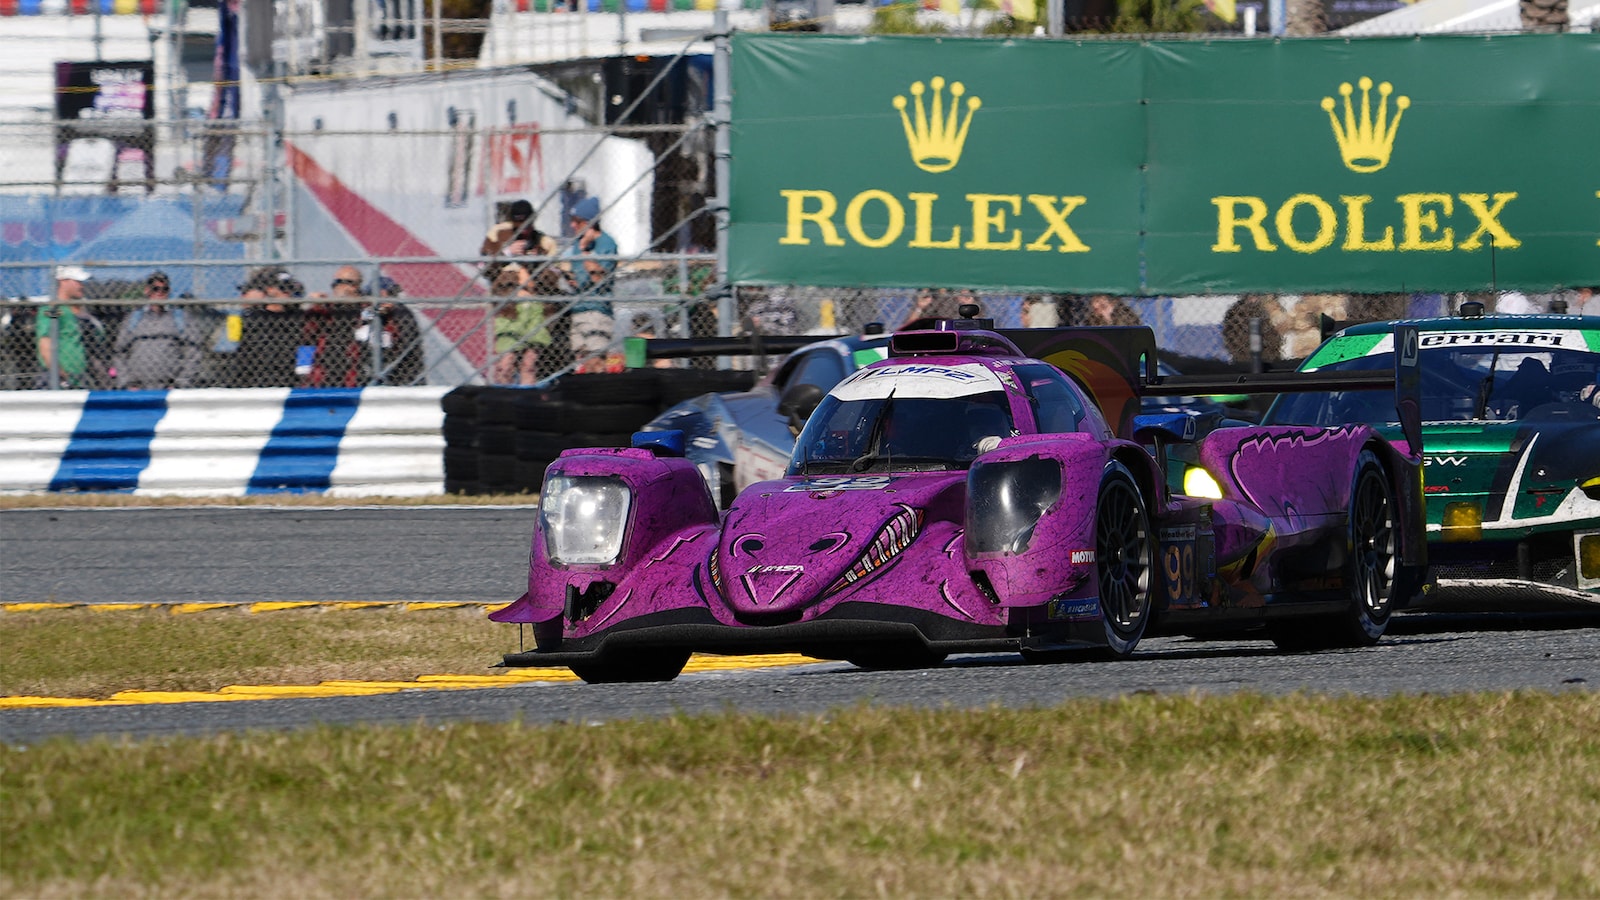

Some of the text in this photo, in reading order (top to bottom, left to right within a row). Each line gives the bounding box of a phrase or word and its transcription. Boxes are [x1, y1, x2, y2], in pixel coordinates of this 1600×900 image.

[779, 189, 1091, 253] ROLEX
[1211, 192, 1521, 253] ROLEX
[1420, 331, 1564, 348] errari
[876, 366, 977, 381] LMP2
[1164, 545, 1194, 600] 99
